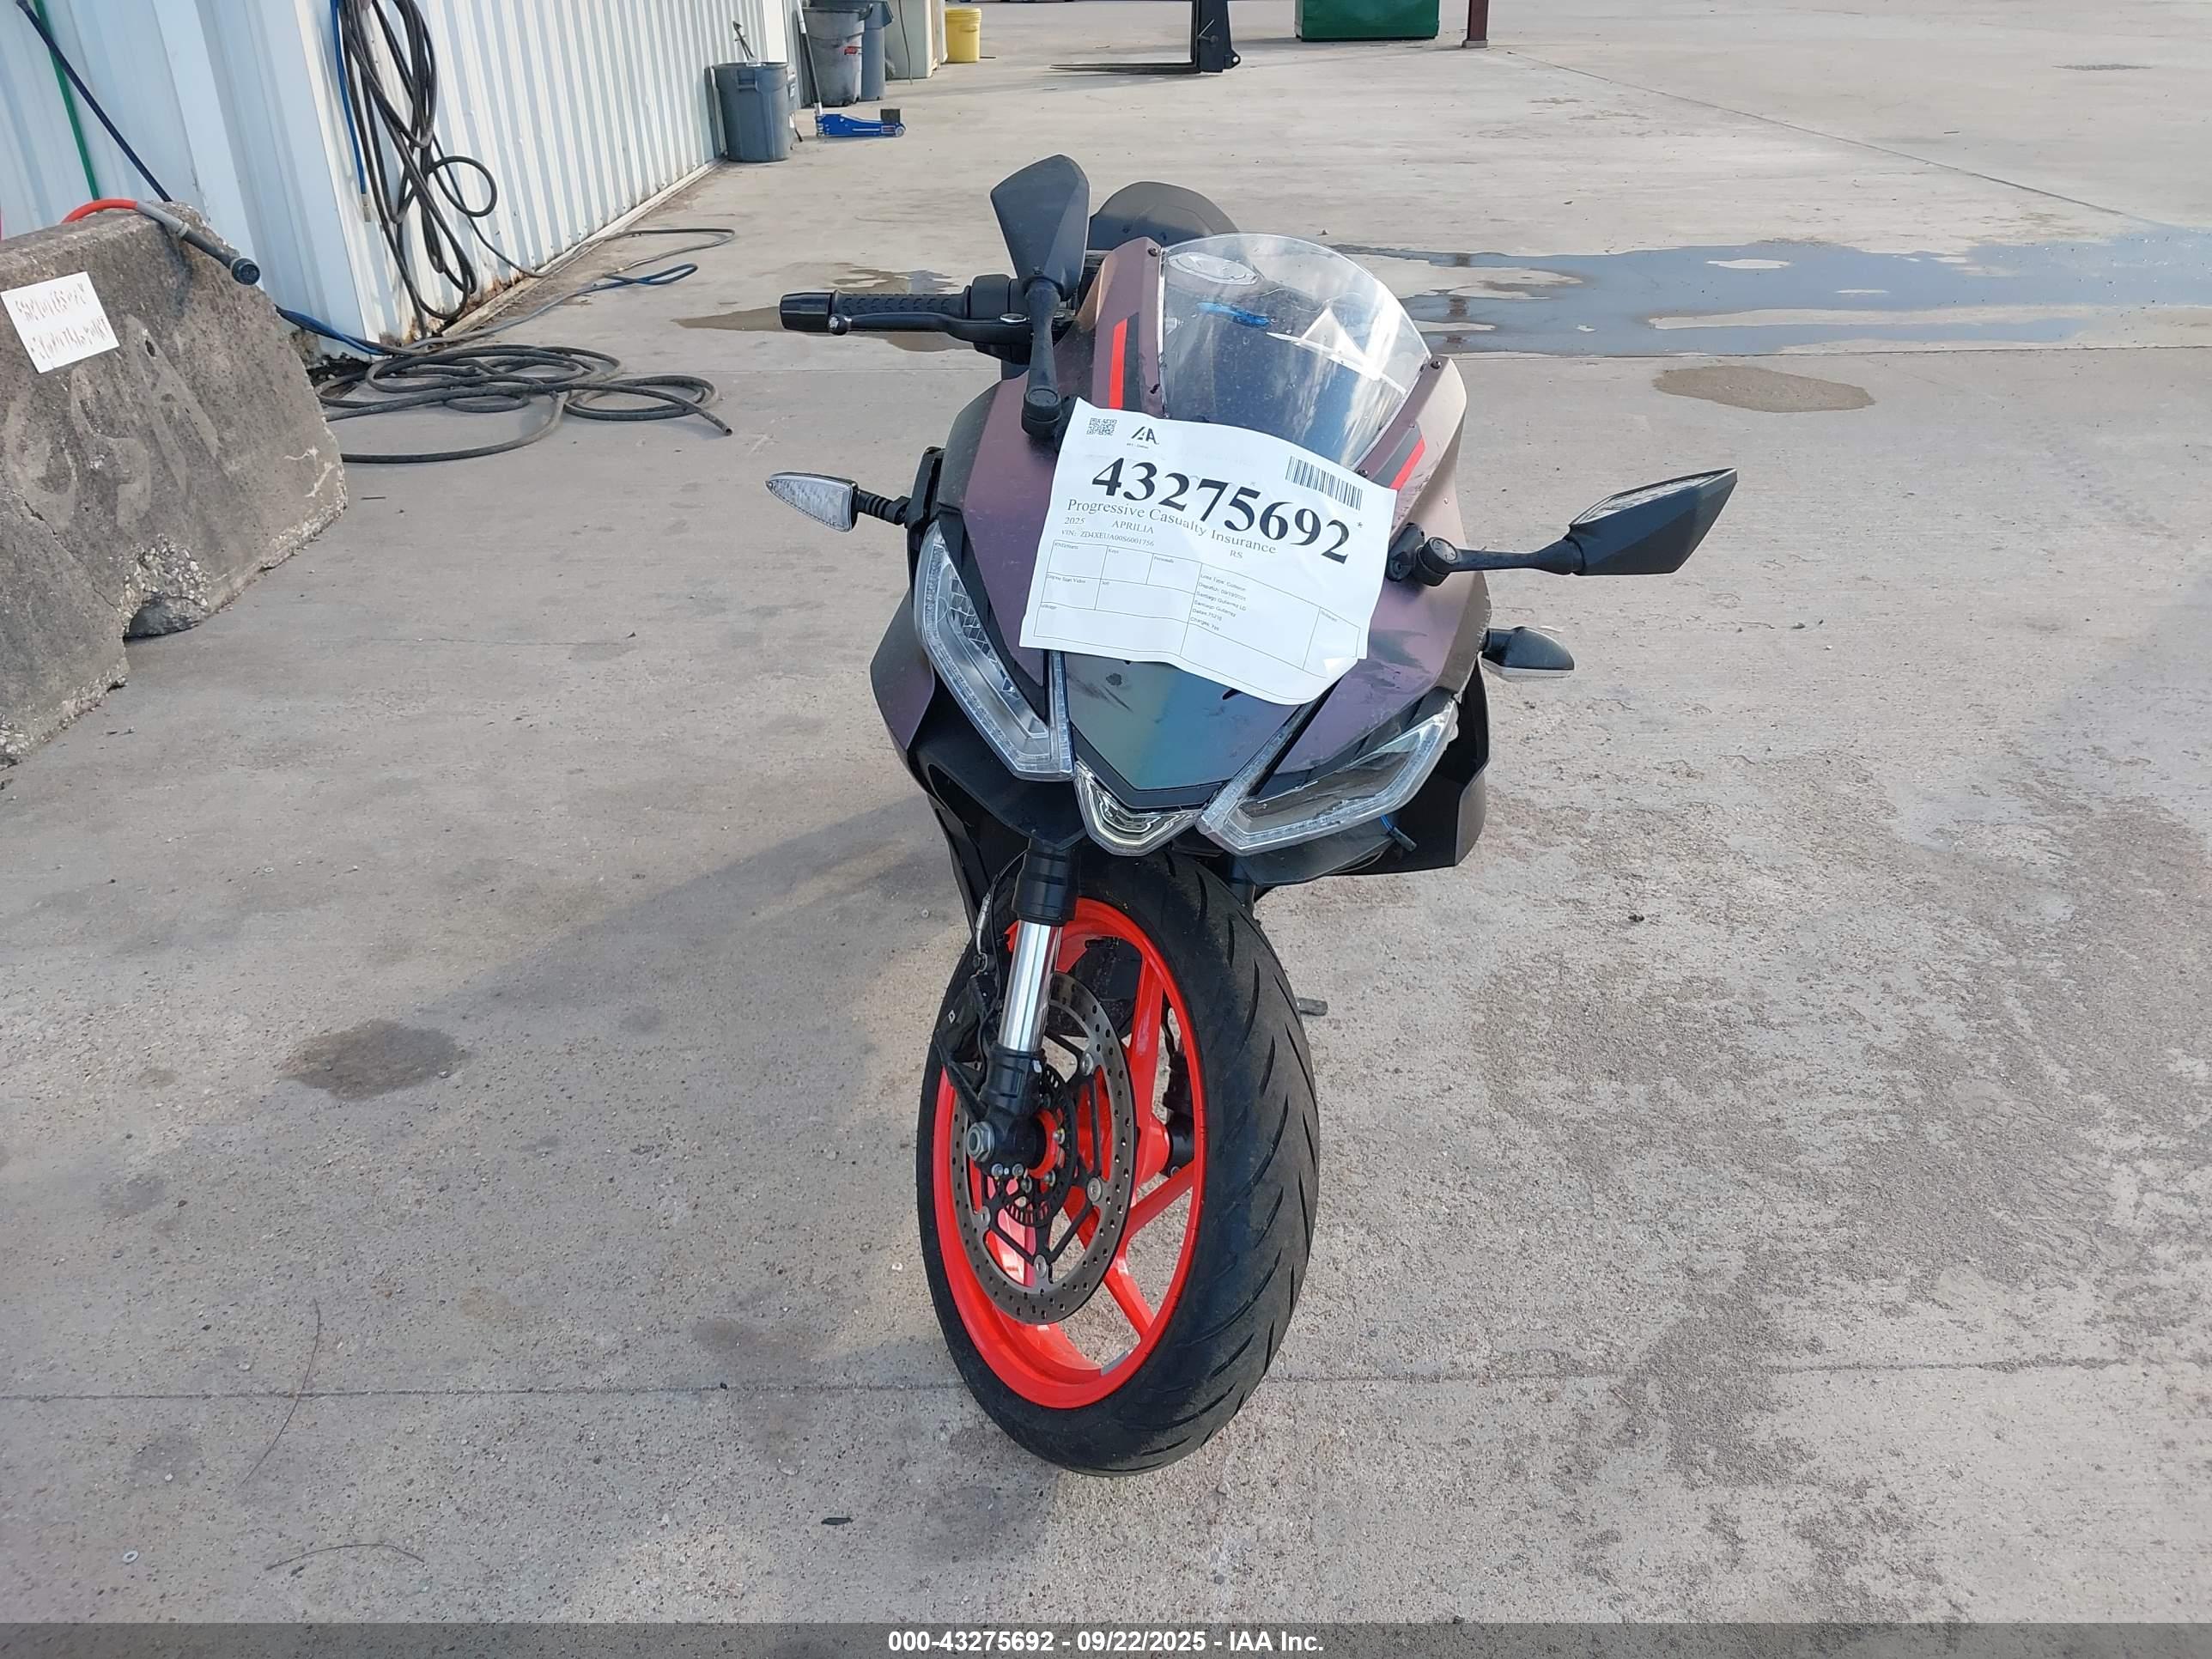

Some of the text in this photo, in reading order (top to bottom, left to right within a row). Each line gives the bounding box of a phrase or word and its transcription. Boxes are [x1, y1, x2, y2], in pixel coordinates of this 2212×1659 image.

[1067, 499, 1277, 554] Progressive Casualty Insurance
[1092, 457, 1349, 564] 43275692
[1112, 520, 1154, 534] APRILIA
[1230, 550, 1243, 558] RS
